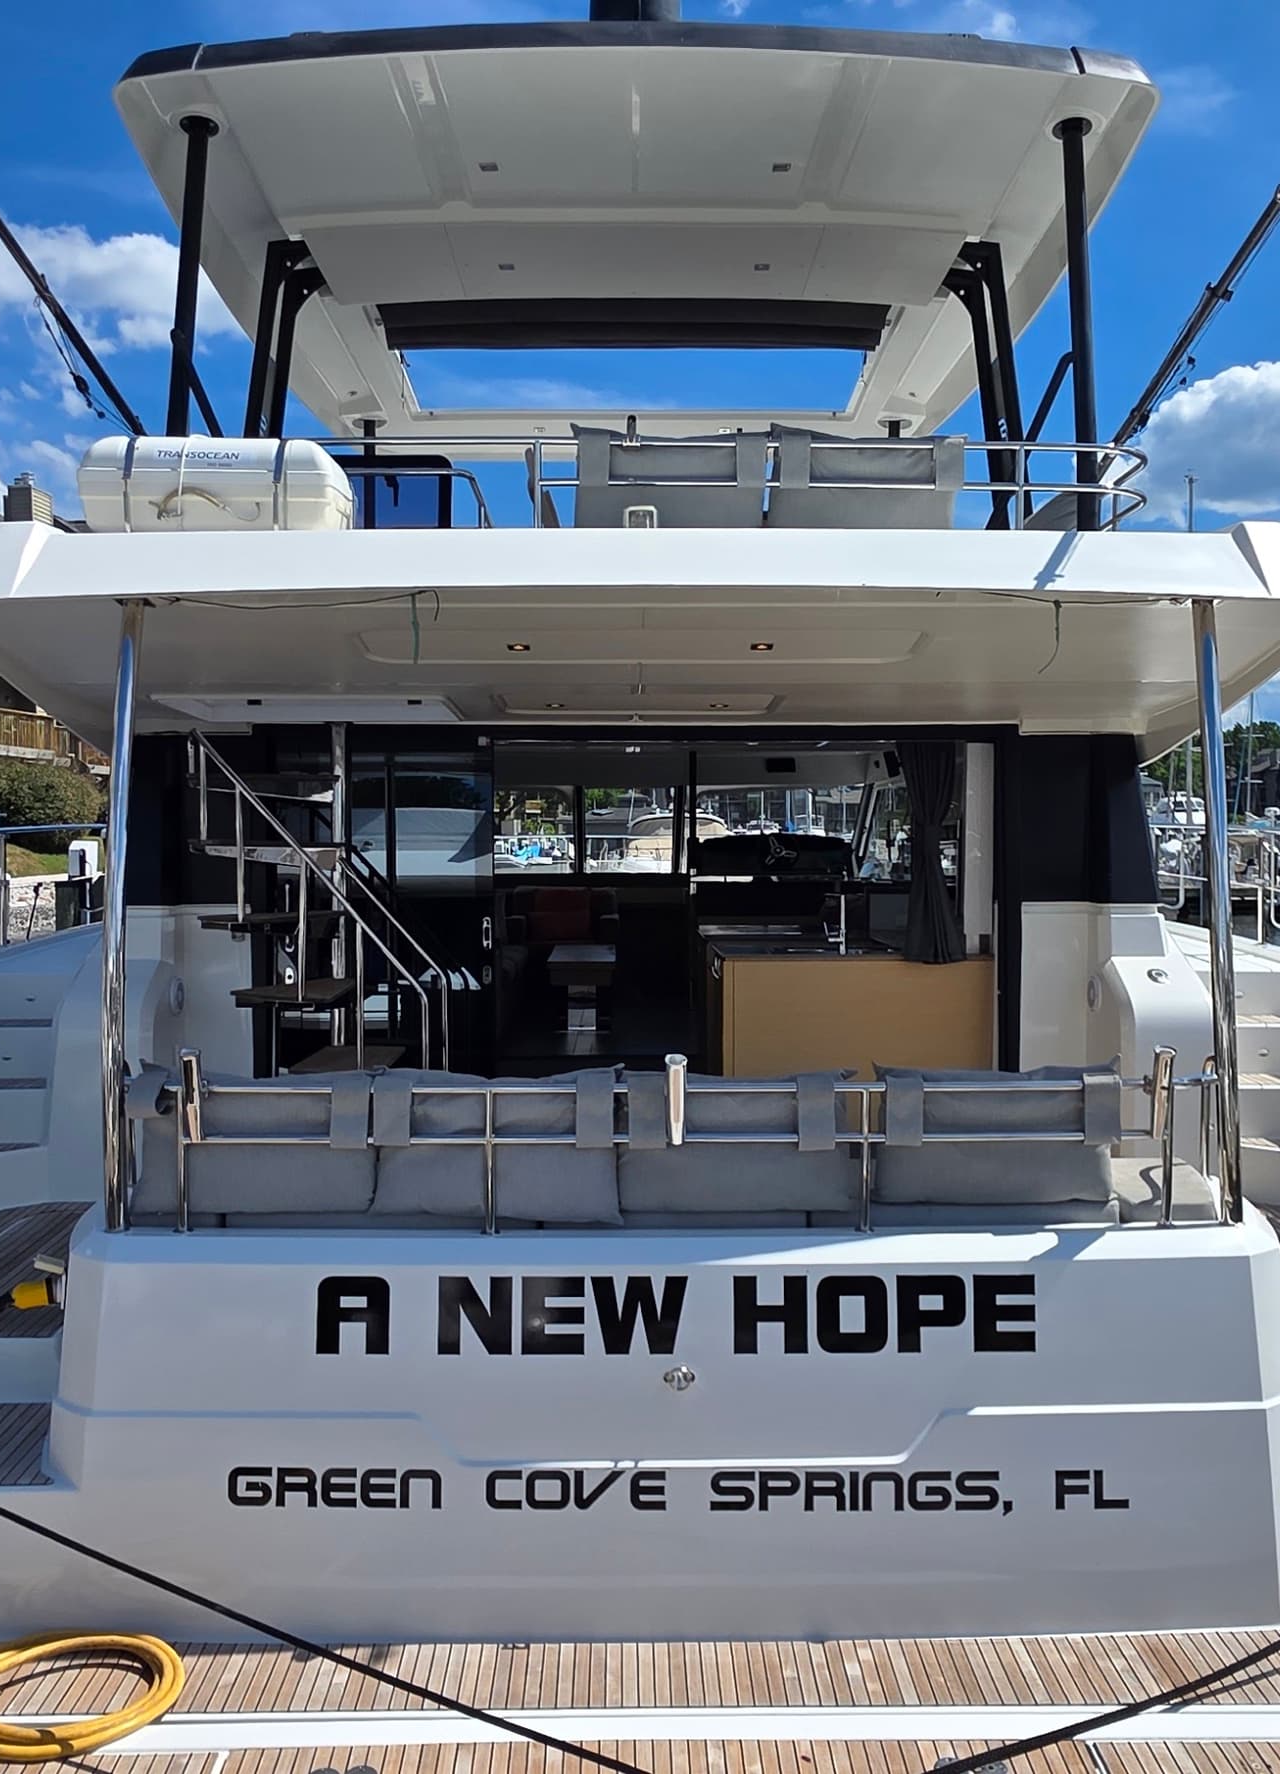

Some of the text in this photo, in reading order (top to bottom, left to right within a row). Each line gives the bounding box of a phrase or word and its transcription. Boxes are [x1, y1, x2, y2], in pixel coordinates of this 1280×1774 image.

[316, 1274, 1036, 1355] A NEW HOPE
[228, 1467, 1129, 1516] GREEN COVE SPRINGS, FL
